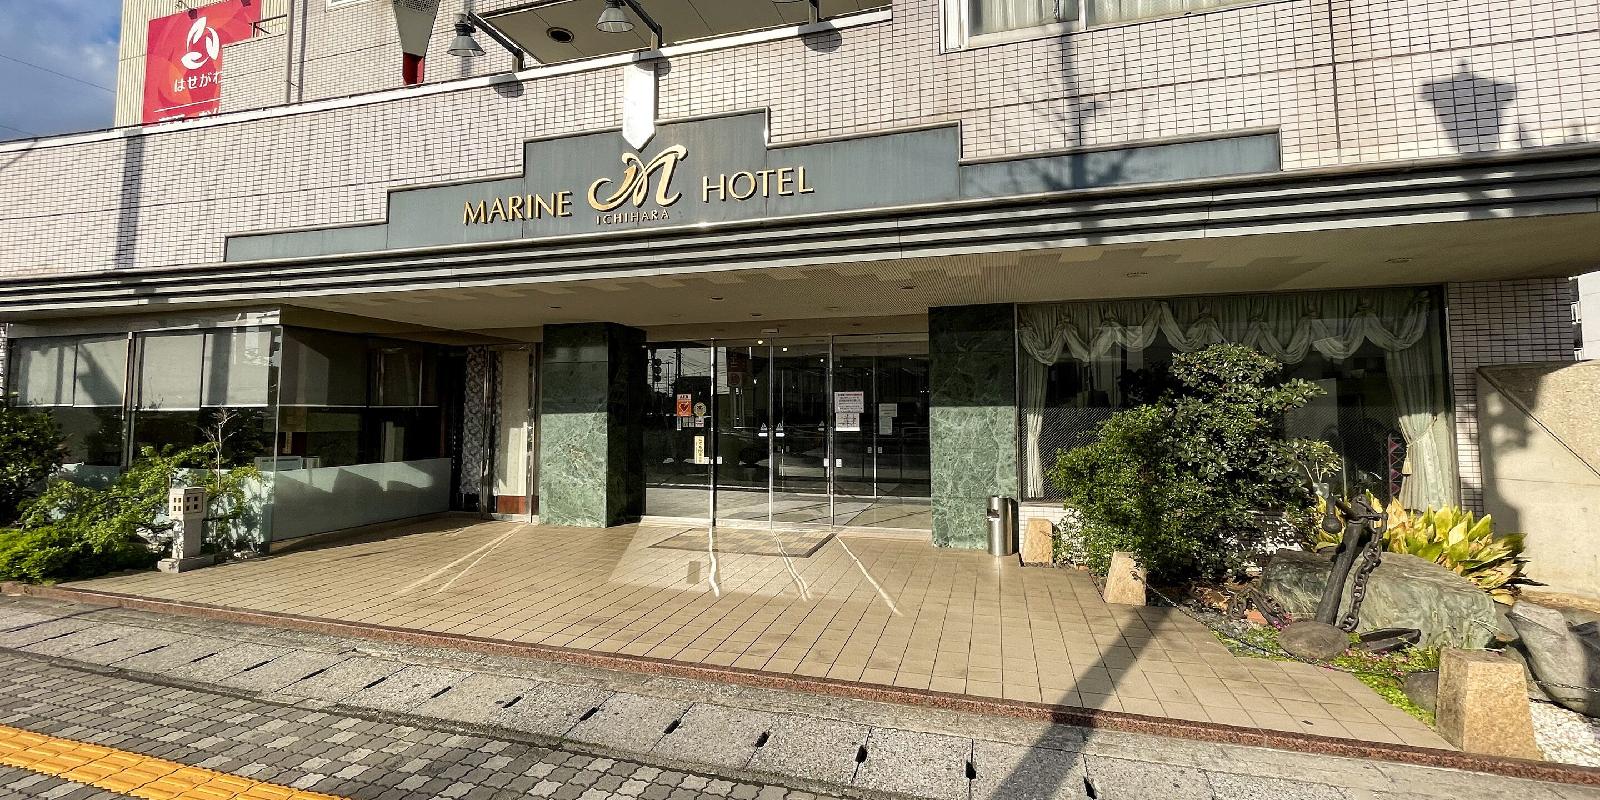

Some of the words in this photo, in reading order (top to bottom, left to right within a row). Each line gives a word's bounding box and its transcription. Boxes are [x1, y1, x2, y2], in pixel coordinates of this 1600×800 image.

[463, 190, 573, 226] MARINE
[702, 165, 815, 203] HOTEL
[596, 208, 671, 225] ICHIHARA
